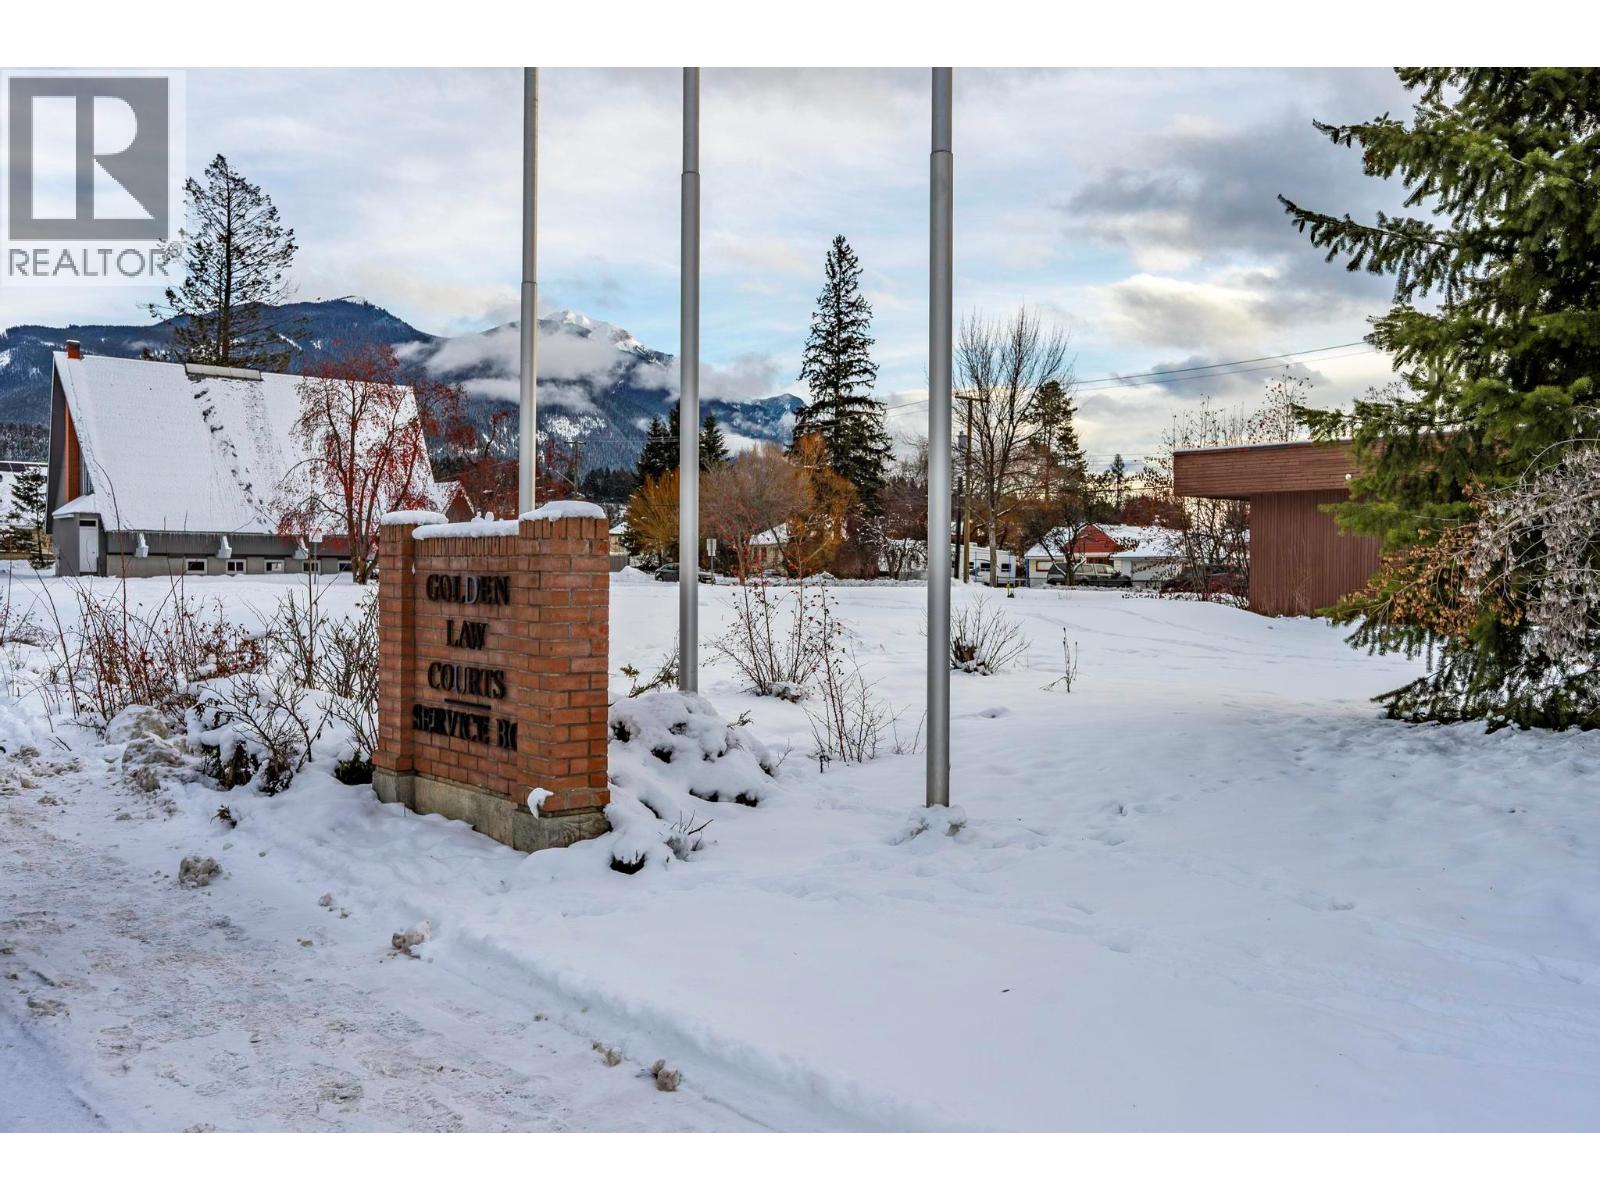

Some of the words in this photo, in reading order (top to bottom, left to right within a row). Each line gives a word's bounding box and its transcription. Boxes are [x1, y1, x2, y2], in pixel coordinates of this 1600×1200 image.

[426, 573, 510, 606] GOLDEN
[446, 619, 488, 651] LAW
[428, 662, 506, 699] COURTS
[412, 704, 490, 745] SERVICE
